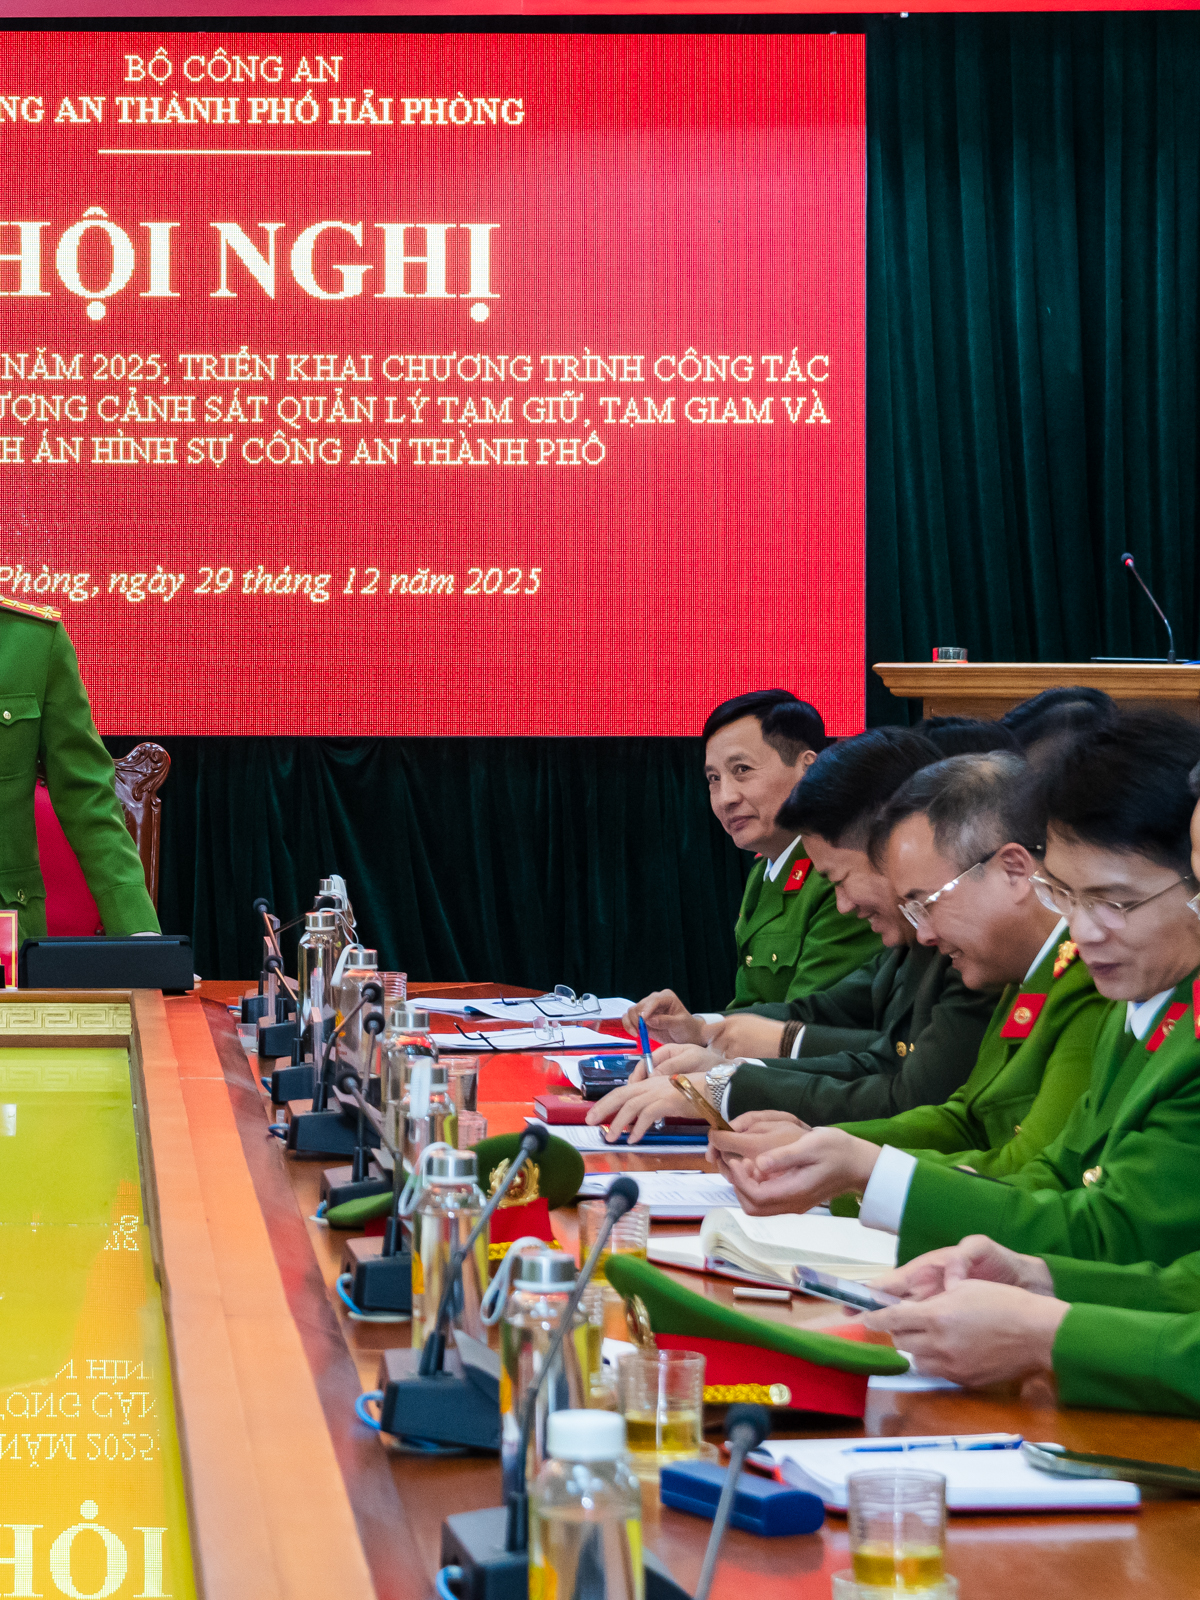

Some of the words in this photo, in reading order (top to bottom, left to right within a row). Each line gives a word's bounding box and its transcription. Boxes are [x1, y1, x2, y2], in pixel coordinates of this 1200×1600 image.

[124, 46, 173, 86] BỘ
[183, 46, 284, 83] CÔNG
[291, 55, 344, 83] AN
[54, 96, 107, 123] AN
[115, 90, 241, 124] THÀNH
[247, 88, 320, 125] PHỐ
[328, 88, 394, 125] HẢI
[400, 91, 526, 125] PHÒNG
[209, 220, 501, 323] NGHỊ
[0, 346, 84, 380] NĂM
[93, 353, 170, 386] 2025;
[178, 345, 280, 381] TRIỂN
[286, 354, 374, 382] KHAI
[382, 350, 534, 382] CHƯƠNG
[540, 346, 646, 382] TRÌNH
[654, 346, 755, 383] CÔNG
[761, 346, 829, 382] TÁC
[97, 386, 196, 423] CẢNH
[205, 386, 269, 423] SÁT
[277, 387, 378, 429] QUẢN
[384, 387, 431, 424] LÝ
[437, 396, 514, 429] TẠM
[522, 389, 591, 429] GIỮ,
[599, 396, 676, 429] TẠM
[684, 396, 775, 424] GIAM
[781, 388, 832, 424] VÀ
[31, 428, 85, 464] ÁN
[91, 428, 179, 465] HÌNH
[187, 433, 234, 469] SỰ
[242, 425, 343, 465] CÔNG
[349, 437, 402, 465] AN
[408, 429, 530, 466] THÀNH
[535, 427, 606, 466] PHỐ
[108, 564, 185, 602] ngày
[193, 566, 234, 594] 29
[242, 564, 332, 603] tháng
[343, 567, 380, 595] 12
[389, 567, 455, 595] năm
[463, 567, 542, 595] 2025
